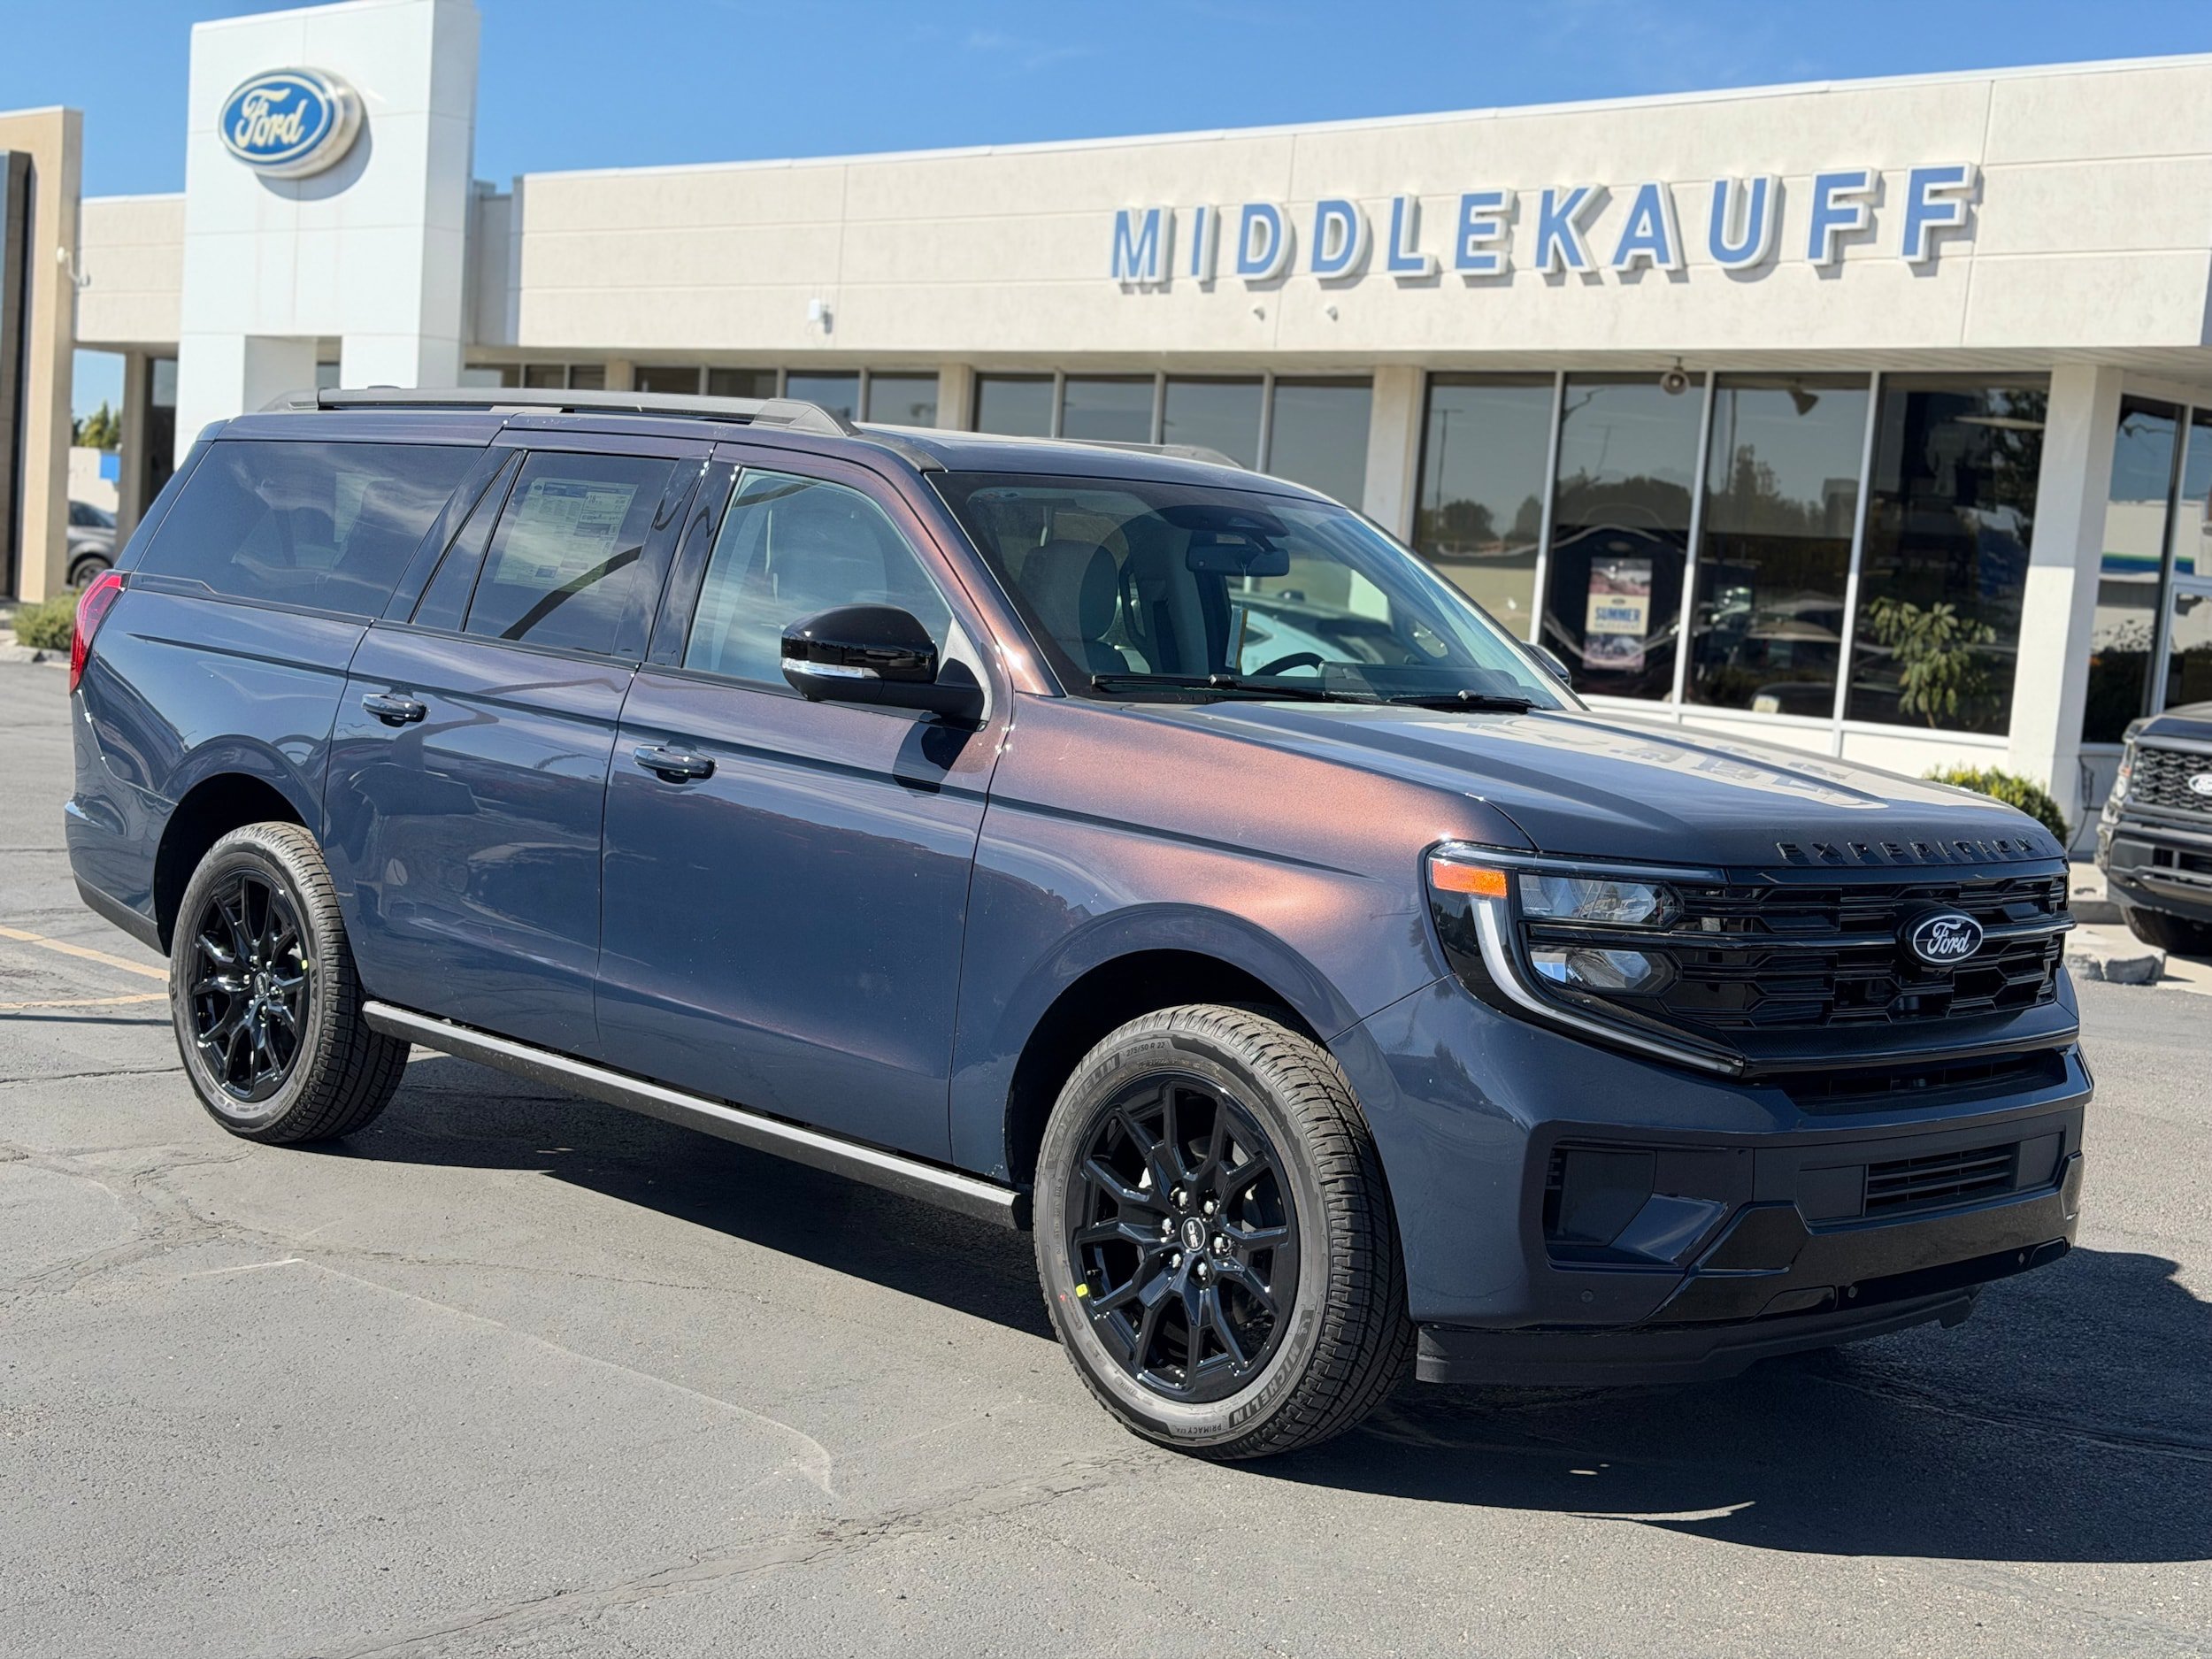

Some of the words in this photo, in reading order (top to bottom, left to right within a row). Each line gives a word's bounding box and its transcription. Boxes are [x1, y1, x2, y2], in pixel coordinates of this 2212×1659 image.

[234, 87, 309, 149] Ford
[1110, 163, 1973, 283] MIDDLEKAUFF
[1595, 606, 1641, 622] SUMMER
[1775, 839, 2034, 860] EXPEDITION
[1926, 921, 1972, 956] Ford
[1125, 1043, 1149, 1057] 275/50
[1056, 1055, 1118, 1141] MICHELIN
[1233, 1342, 1301, 1426] MICHELIN
[1187, 1423, 1222, 1434] PRIMACY
